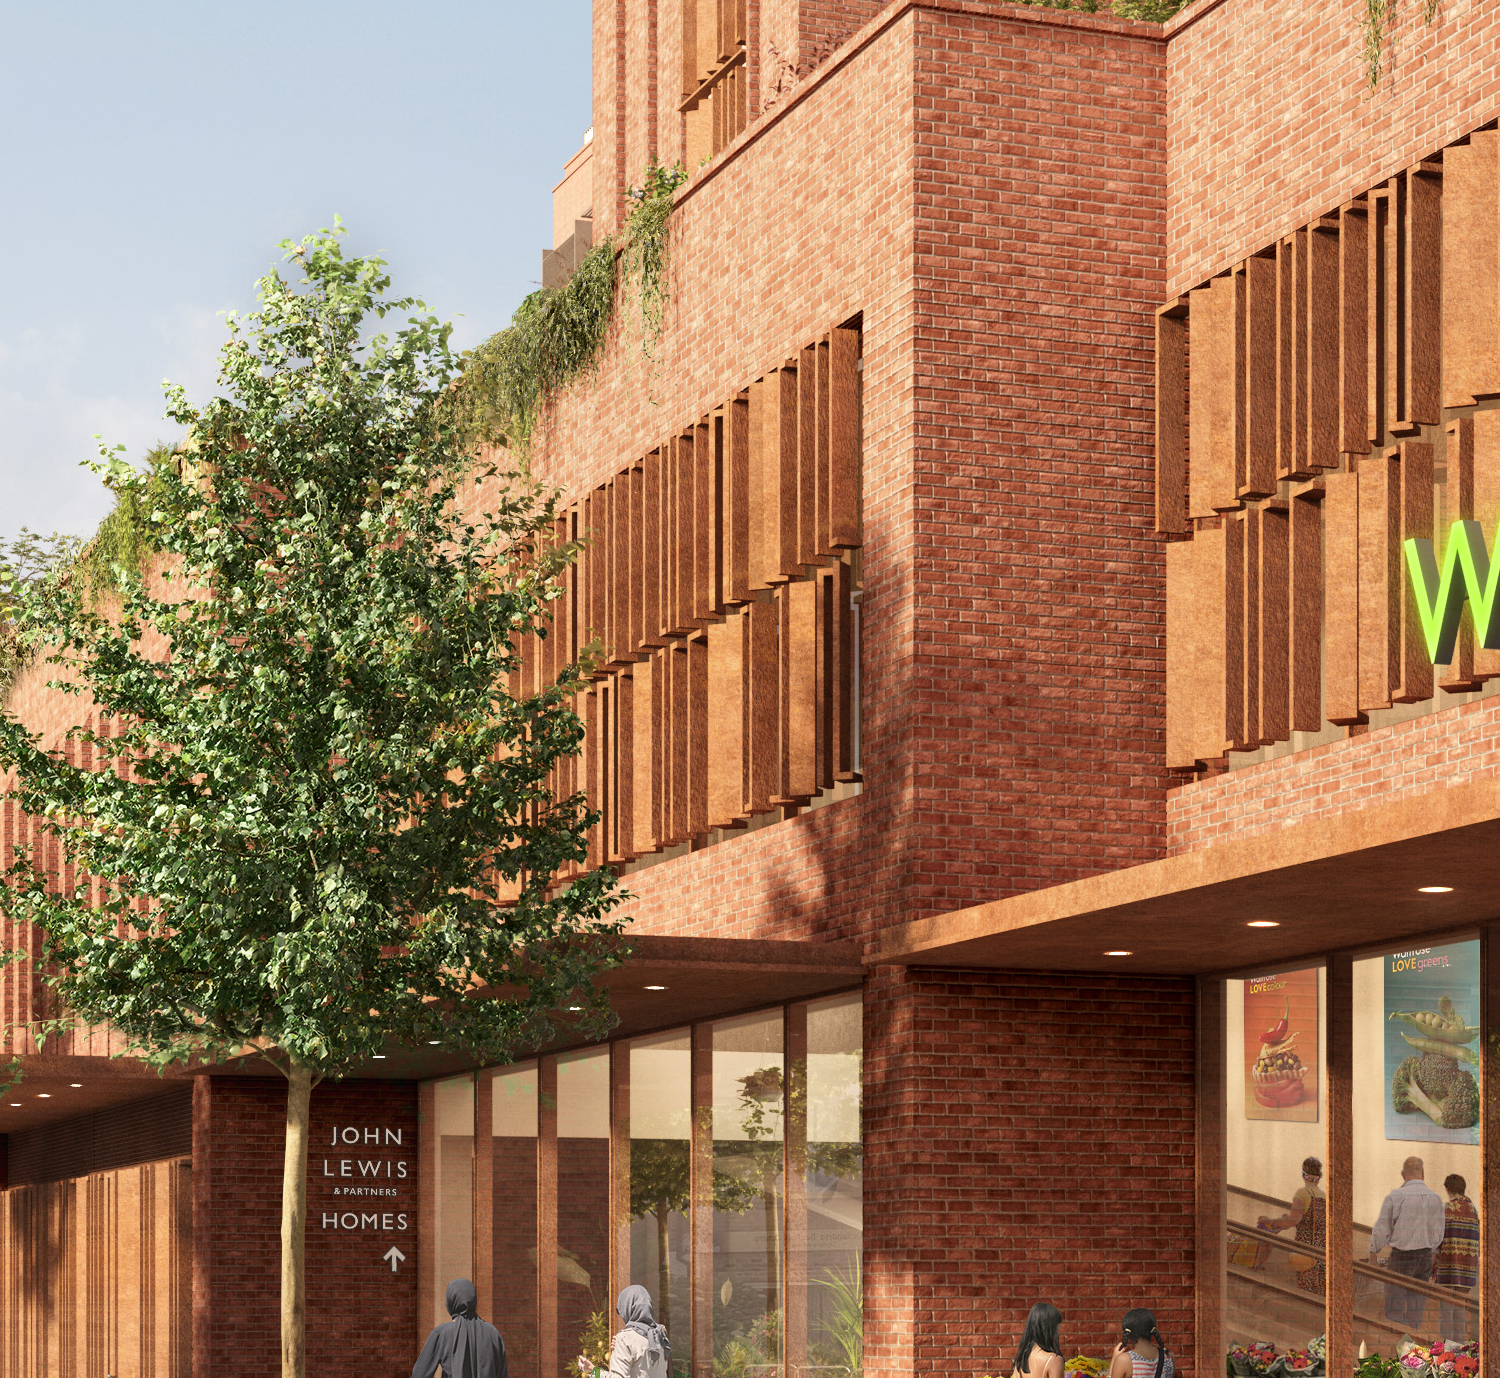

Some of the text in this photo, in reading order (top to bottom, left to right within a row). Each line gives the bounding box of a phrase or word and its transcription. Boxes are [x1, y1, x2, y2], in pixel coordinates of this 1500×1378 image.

[1392, 955, 1448, 972] LOVE greens
[1250, 983, 1266, 994] LOVE
[331, 1127, 402, 1146] JOHN
[324, 1159, 407, 1178] LEWIS
[333, 1187, 397, 1196] & PARTNERS
[322, 1212, 408, 1231] HOMES
